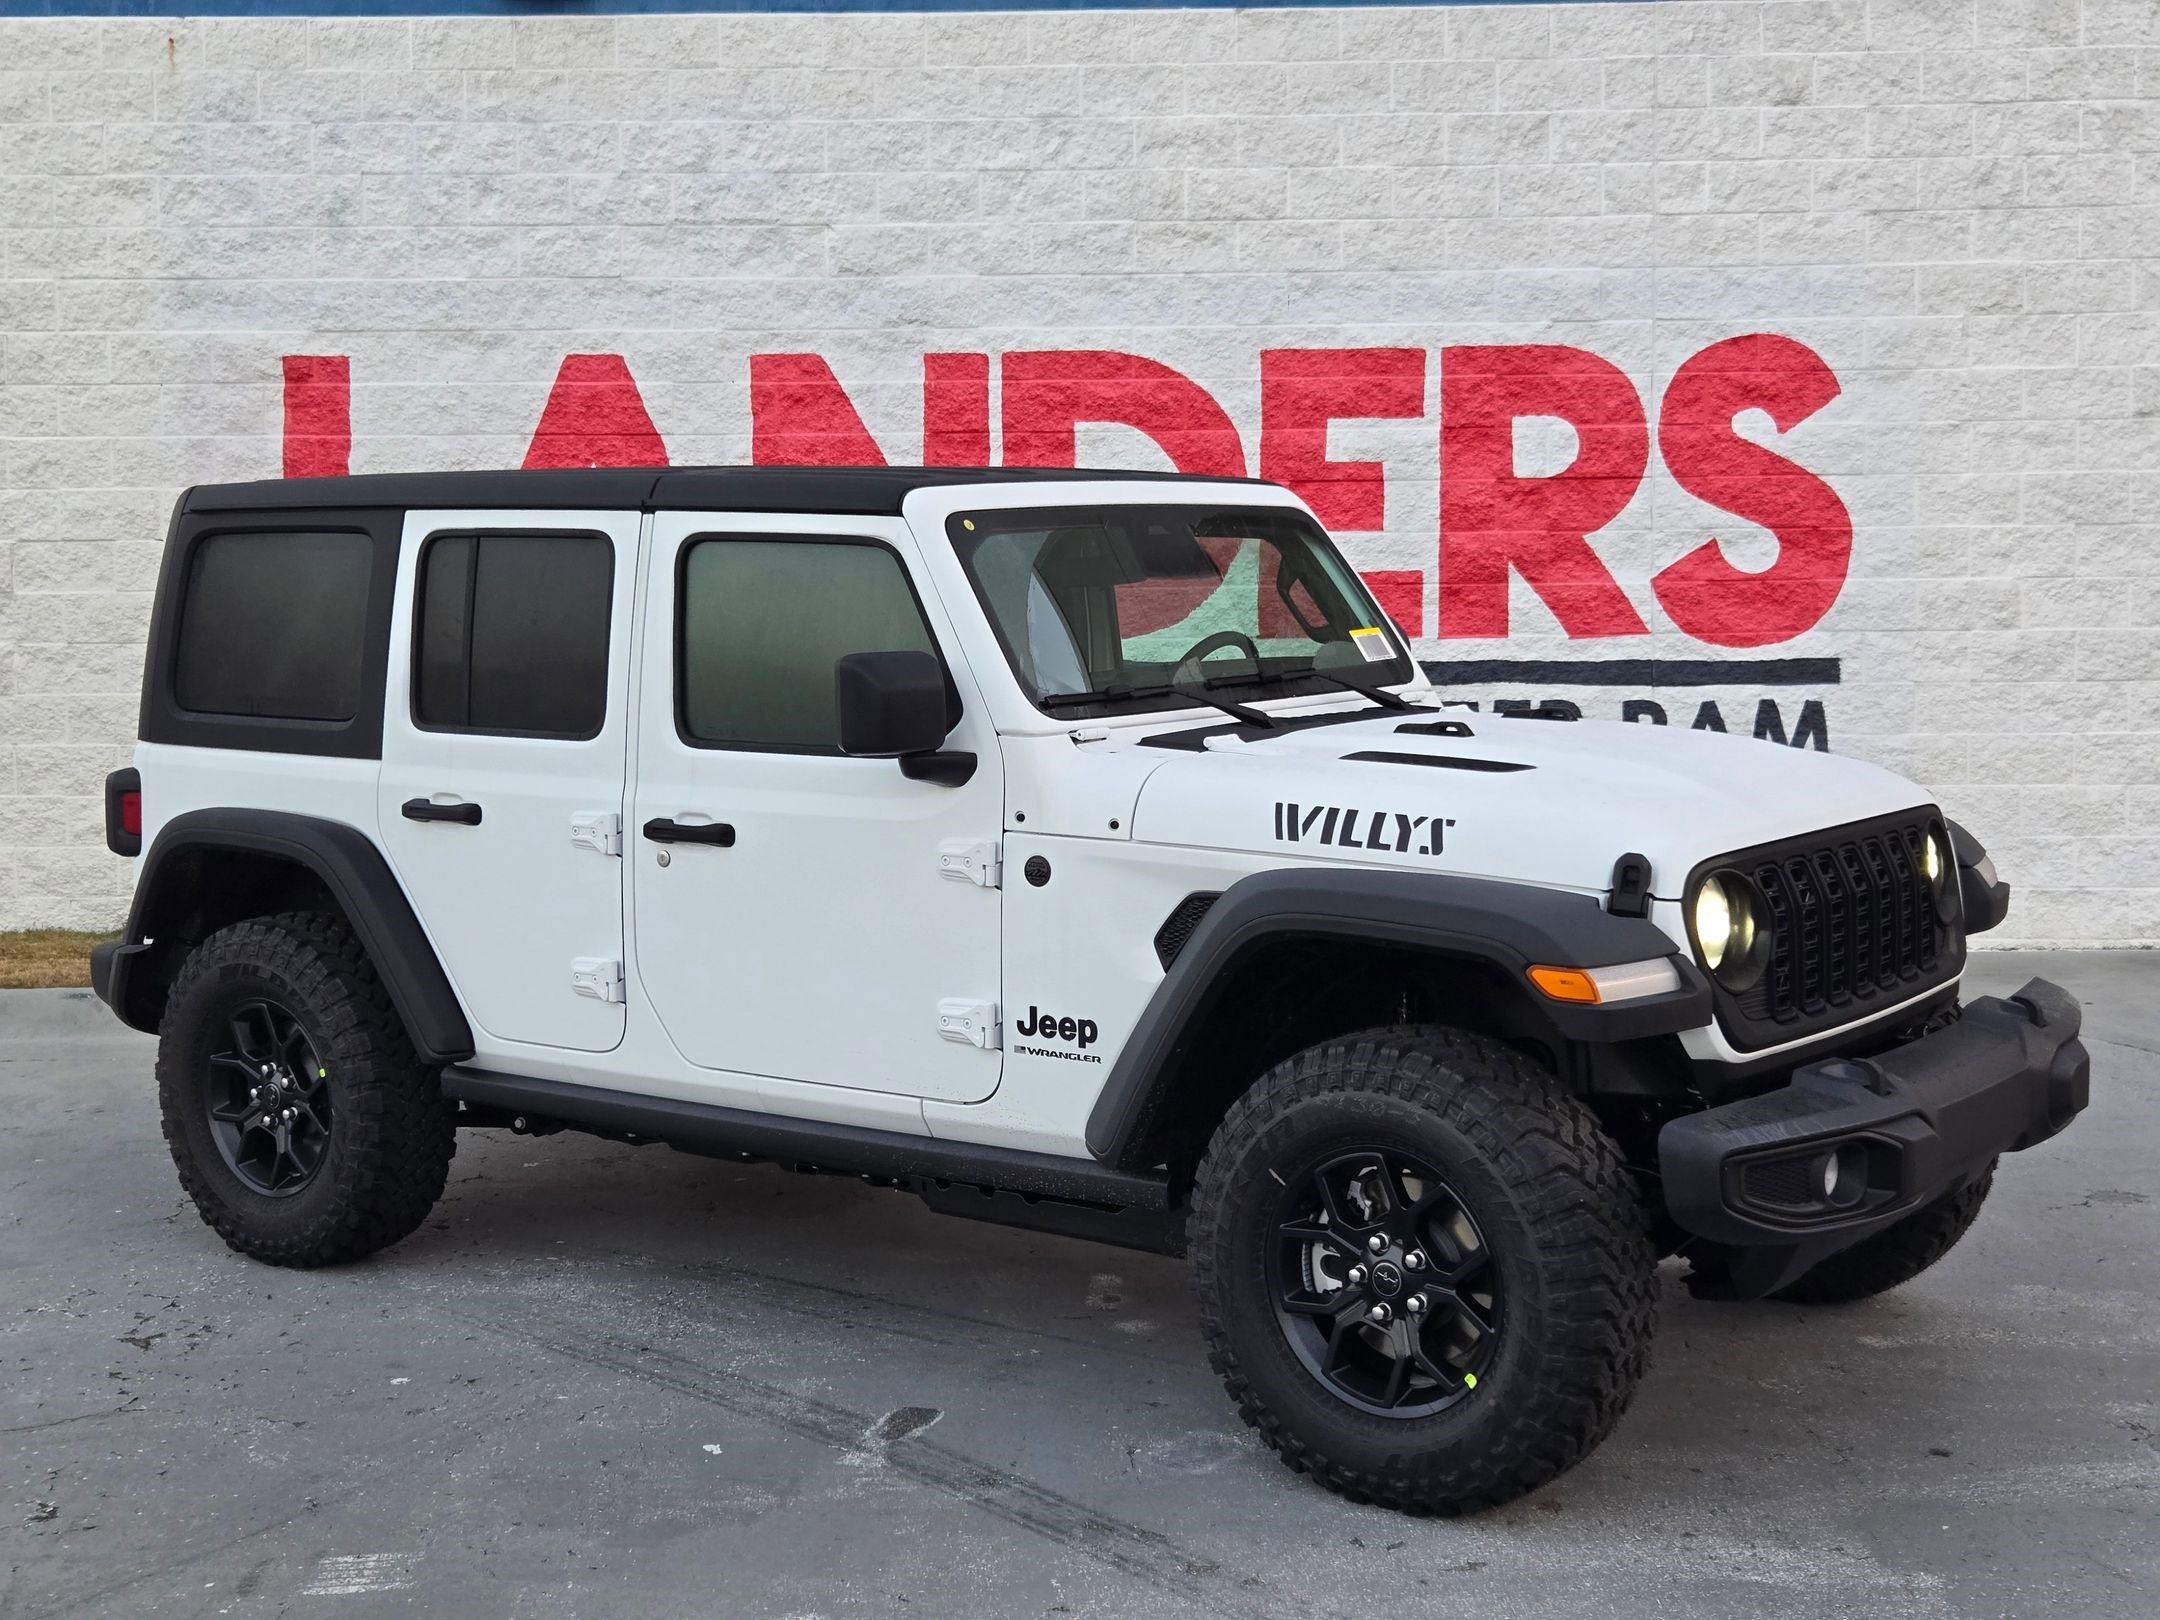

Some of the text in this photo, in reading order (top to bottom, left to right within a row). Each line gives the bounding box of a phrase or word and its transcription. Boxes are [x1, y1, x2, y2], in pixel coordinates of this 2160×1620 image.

[1274, 802, 1456, 856] WILLYS
[1016, 1005, 1098, 1049] Jeep
[1026, 1046, 1102, 1064] WRANGLER
